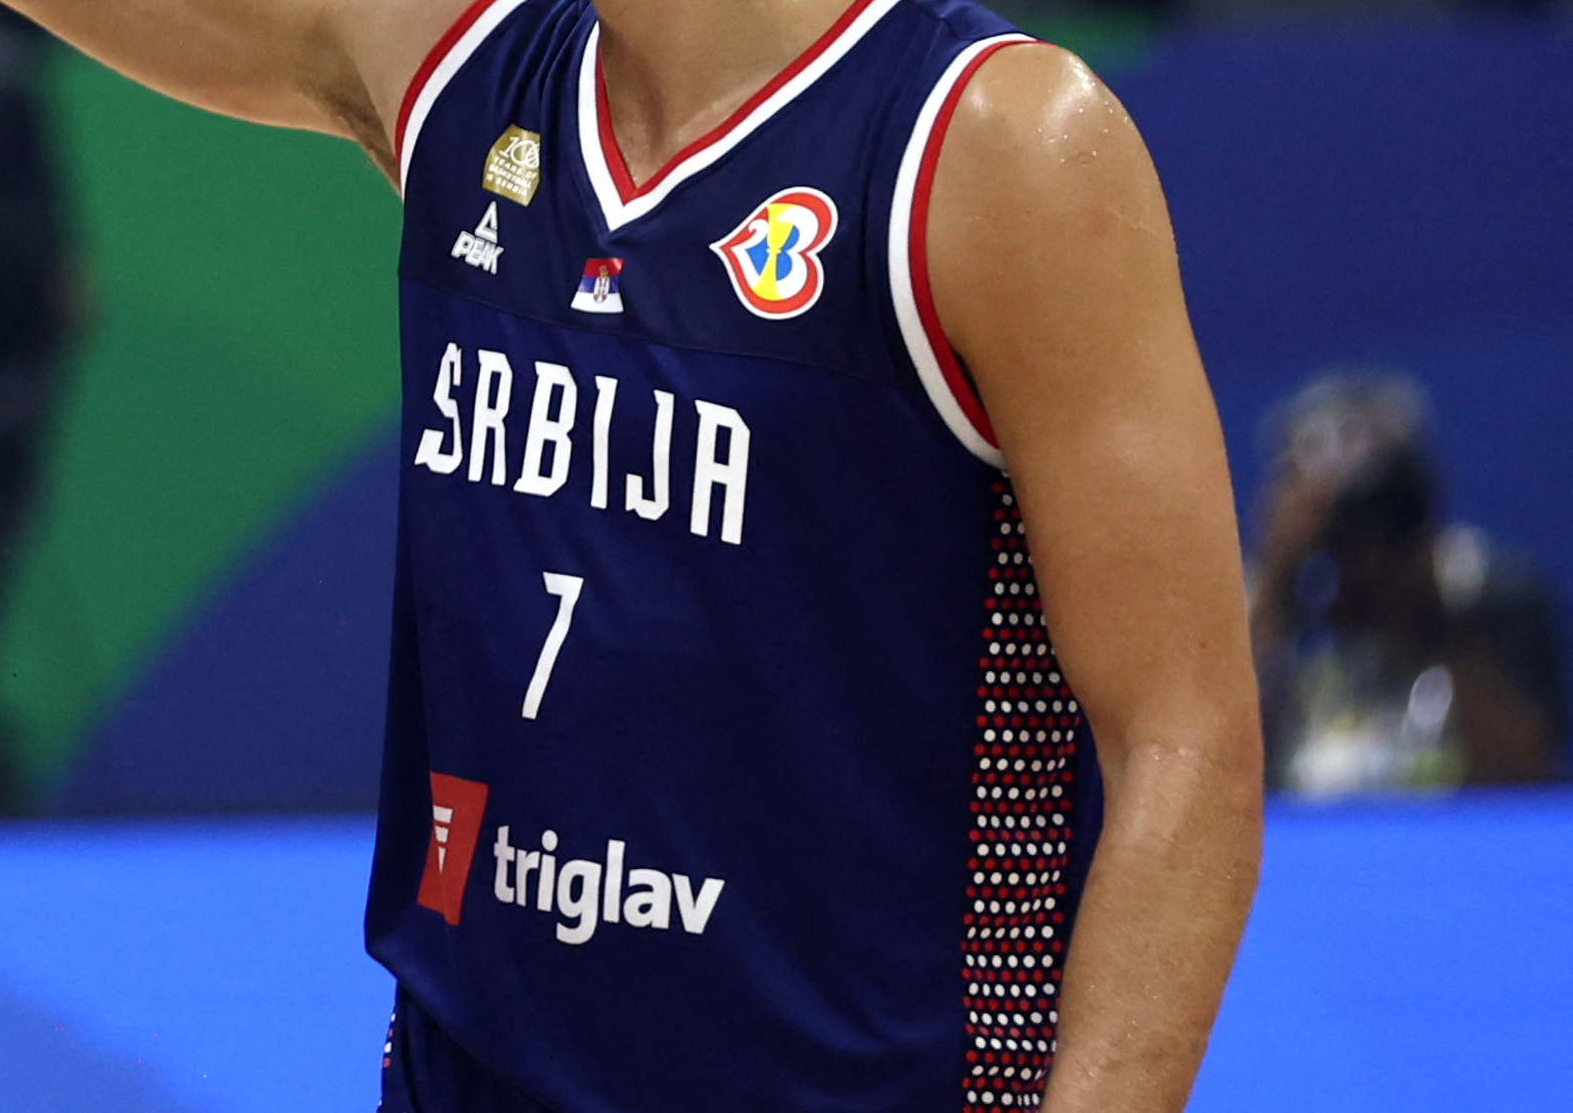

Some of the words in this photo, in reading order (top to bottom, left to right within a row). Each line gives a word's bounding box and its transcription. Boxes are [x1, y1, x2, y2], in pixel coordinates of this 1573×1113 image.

[450, 230, 505, 275] PEAK
[414, 342, 751, 545] SRBIJA
[522, 571, 584, 720] 7
[493, 824, 726, 945] triglav
